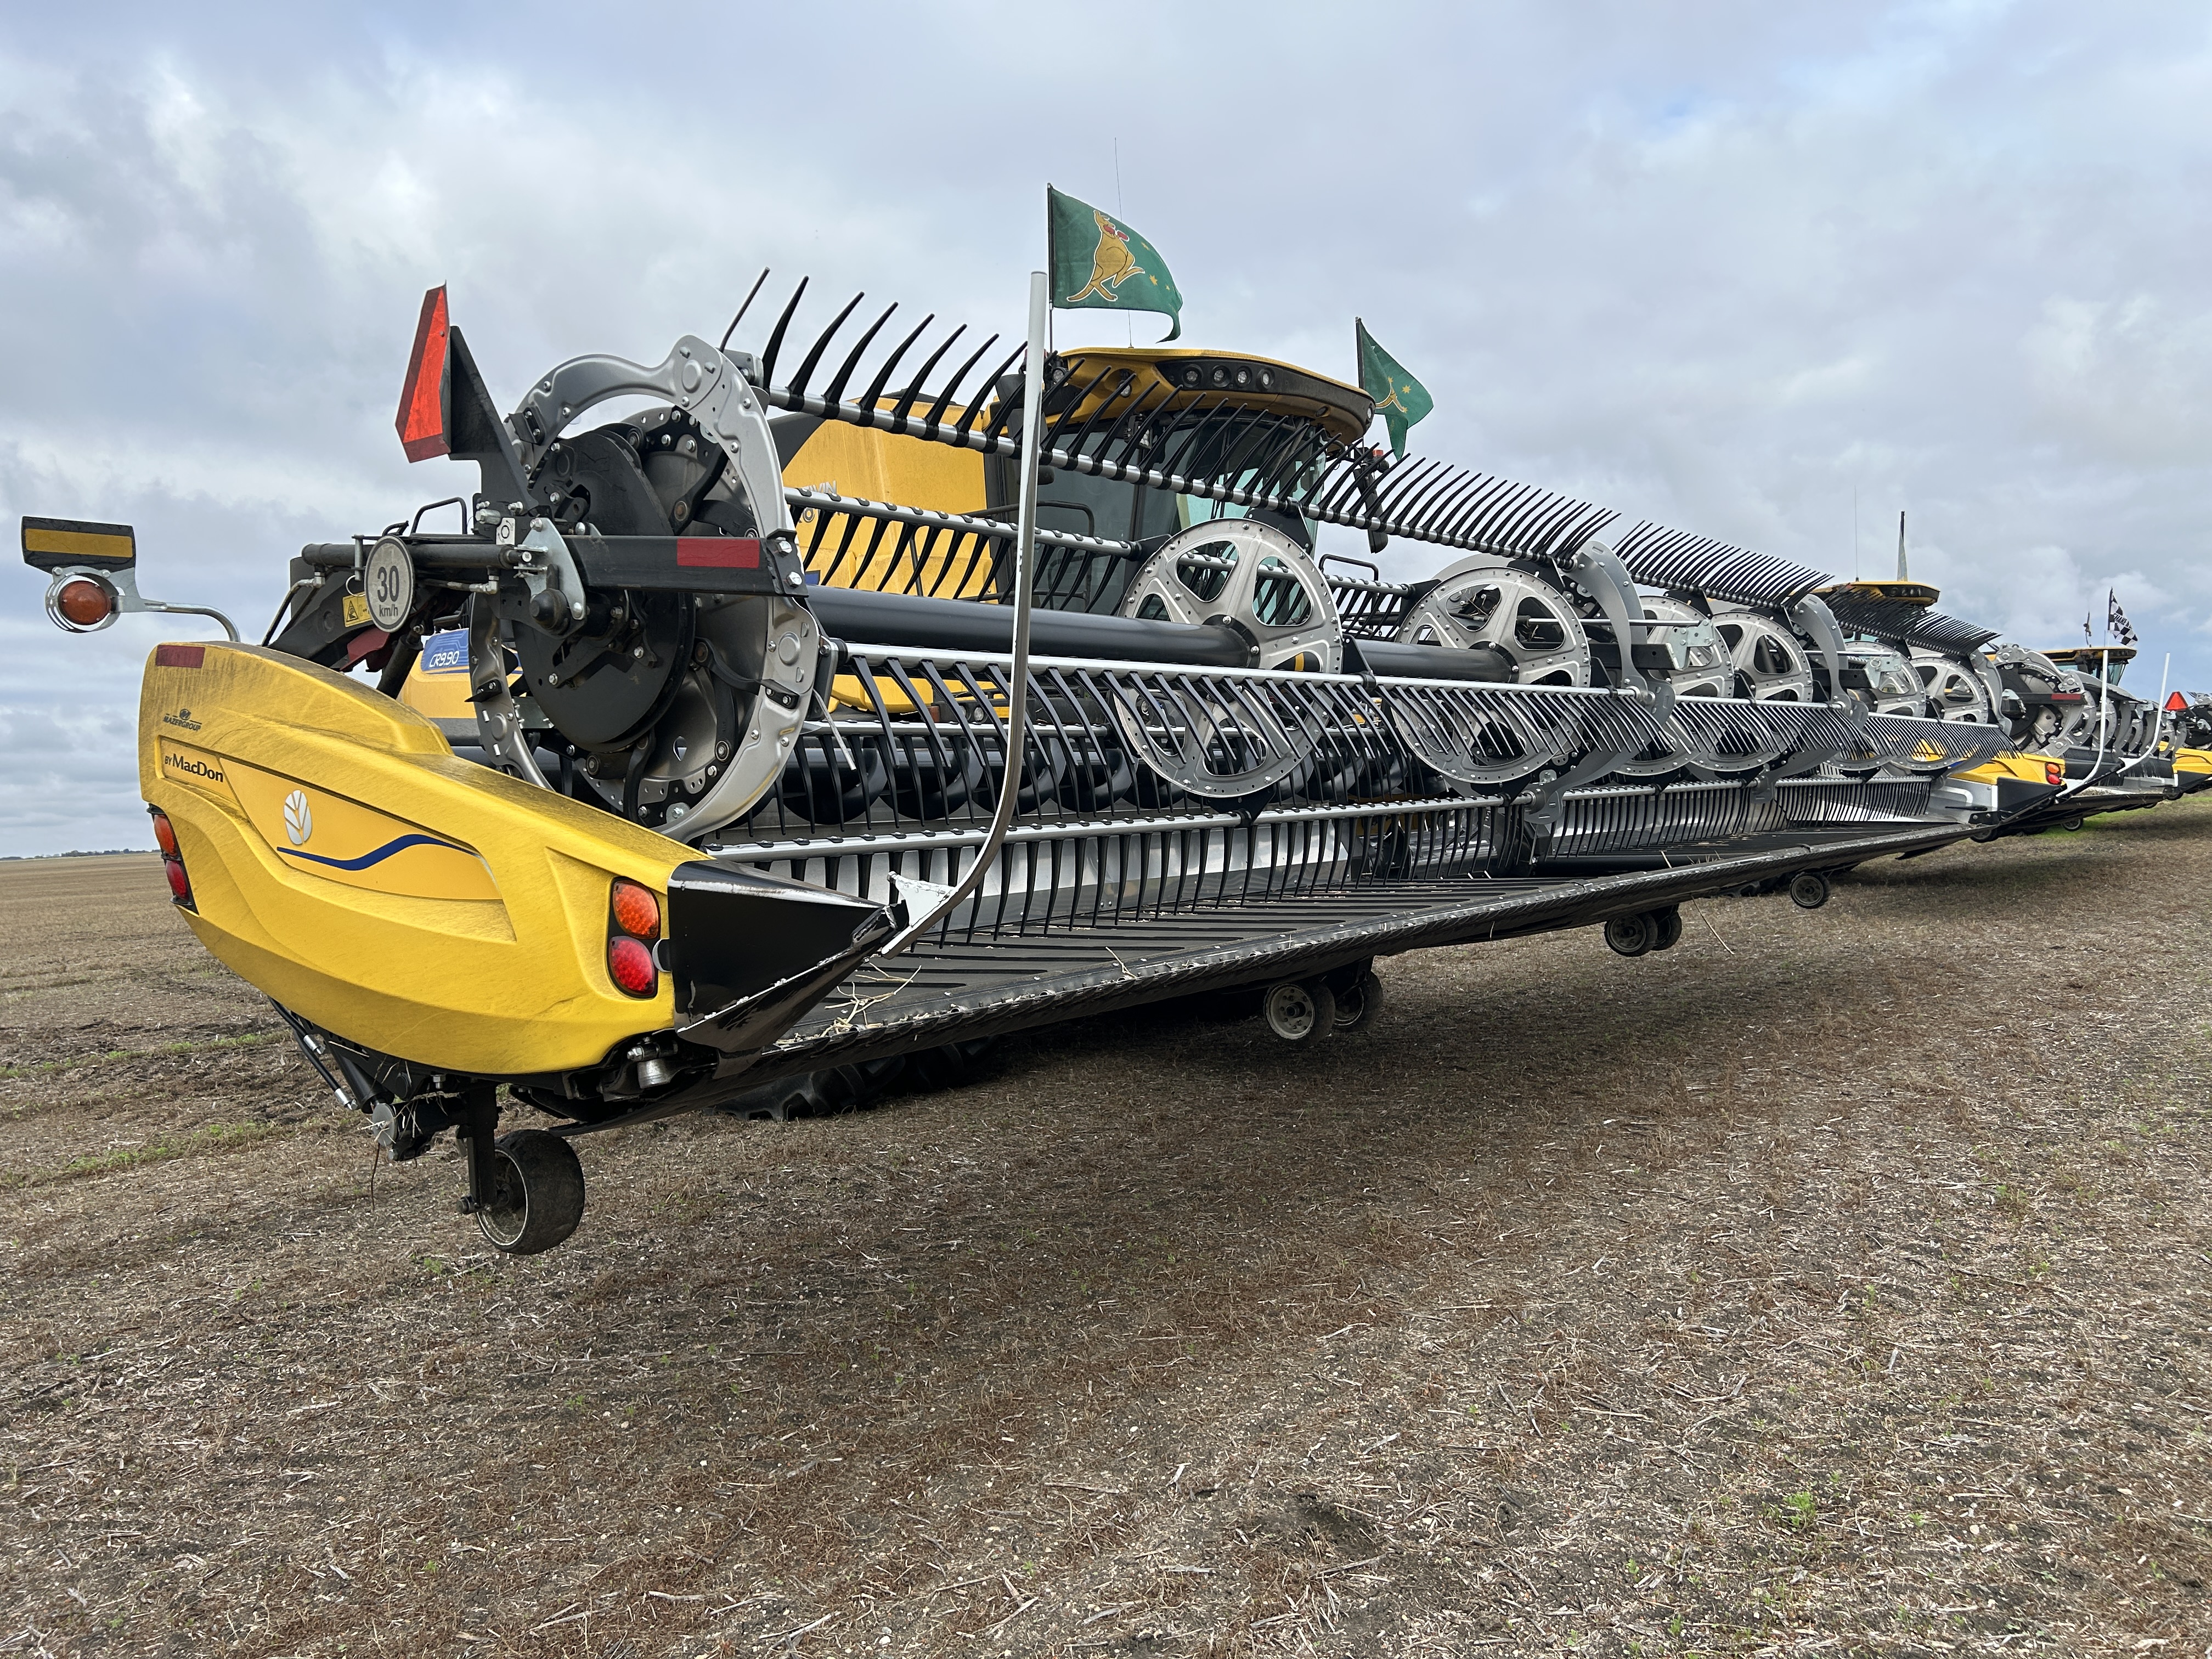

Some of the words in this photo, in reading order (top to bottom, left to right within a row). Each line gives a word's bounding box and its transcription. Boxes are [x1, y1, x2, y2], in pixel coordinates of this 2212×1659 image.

[377, 566, 399, 602] 30
[379, 604, 398, 617] km/h
[165, 755, 172, 765] BY
[172, 753, 223, 782] MacDon
